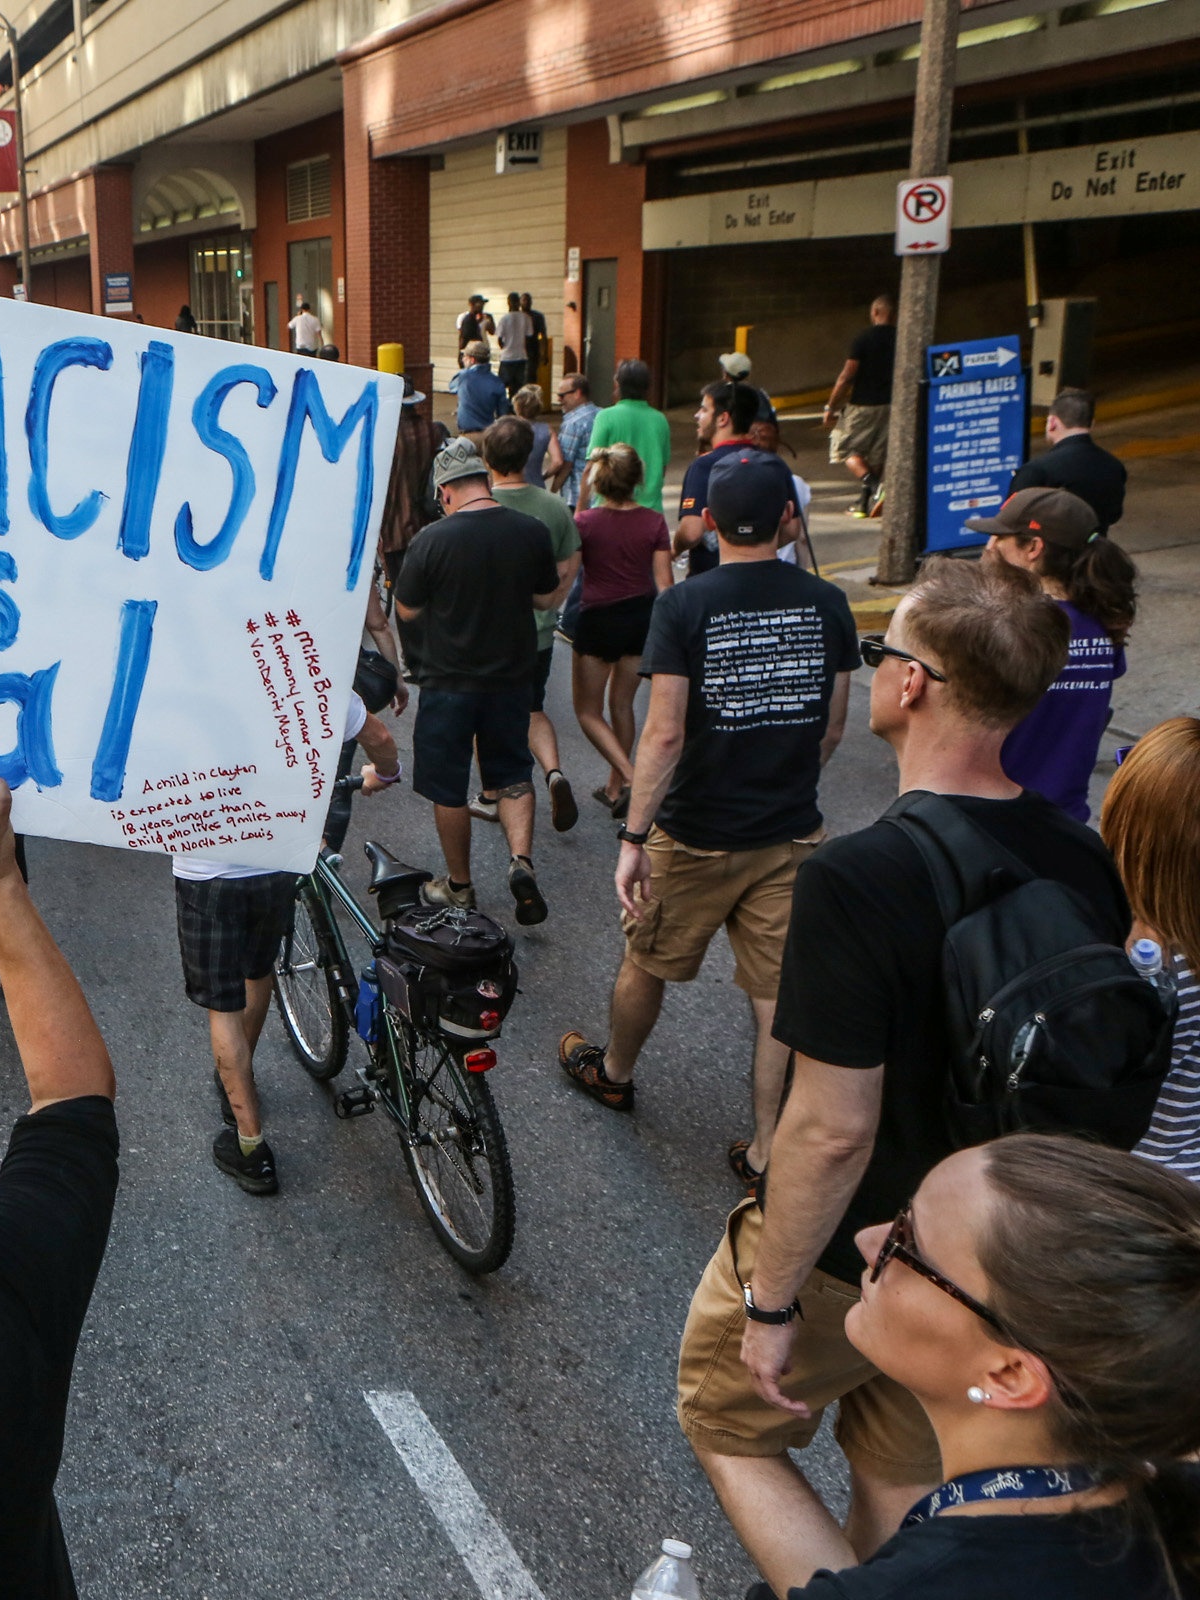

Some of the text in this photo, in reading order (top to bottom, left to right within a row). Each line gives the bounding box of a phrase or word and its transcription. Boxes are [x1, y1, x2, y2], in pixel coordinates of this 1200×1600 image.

[508, 131, 539, 151] EXIT
[1096, 150, 1136, 172] Exit
[1051, 171, 1185, 200] Do Not Enter
[748, 195, 770, 210] Exit
[726, 210, 796, 229] Do Not Enter
[939, 376, 1017, 400] PARKING RATES
[1069, 639, 1088, 647] LICE
[142, 764, 257, 794] A child in Clayton
[110, 786, 242, 820] is expected to live
[122, 800, 266, 836] 18 years longer than a
[128, 831, 164, 848] child
[167, 829, 191, 841] who
[192, 819, 221, 833] lives
[275, 809, 306, 823] away
[181, 837, 216, 852] North
[219, 834, 237, 845] St.
[241, 828, 274, 841] Louis
